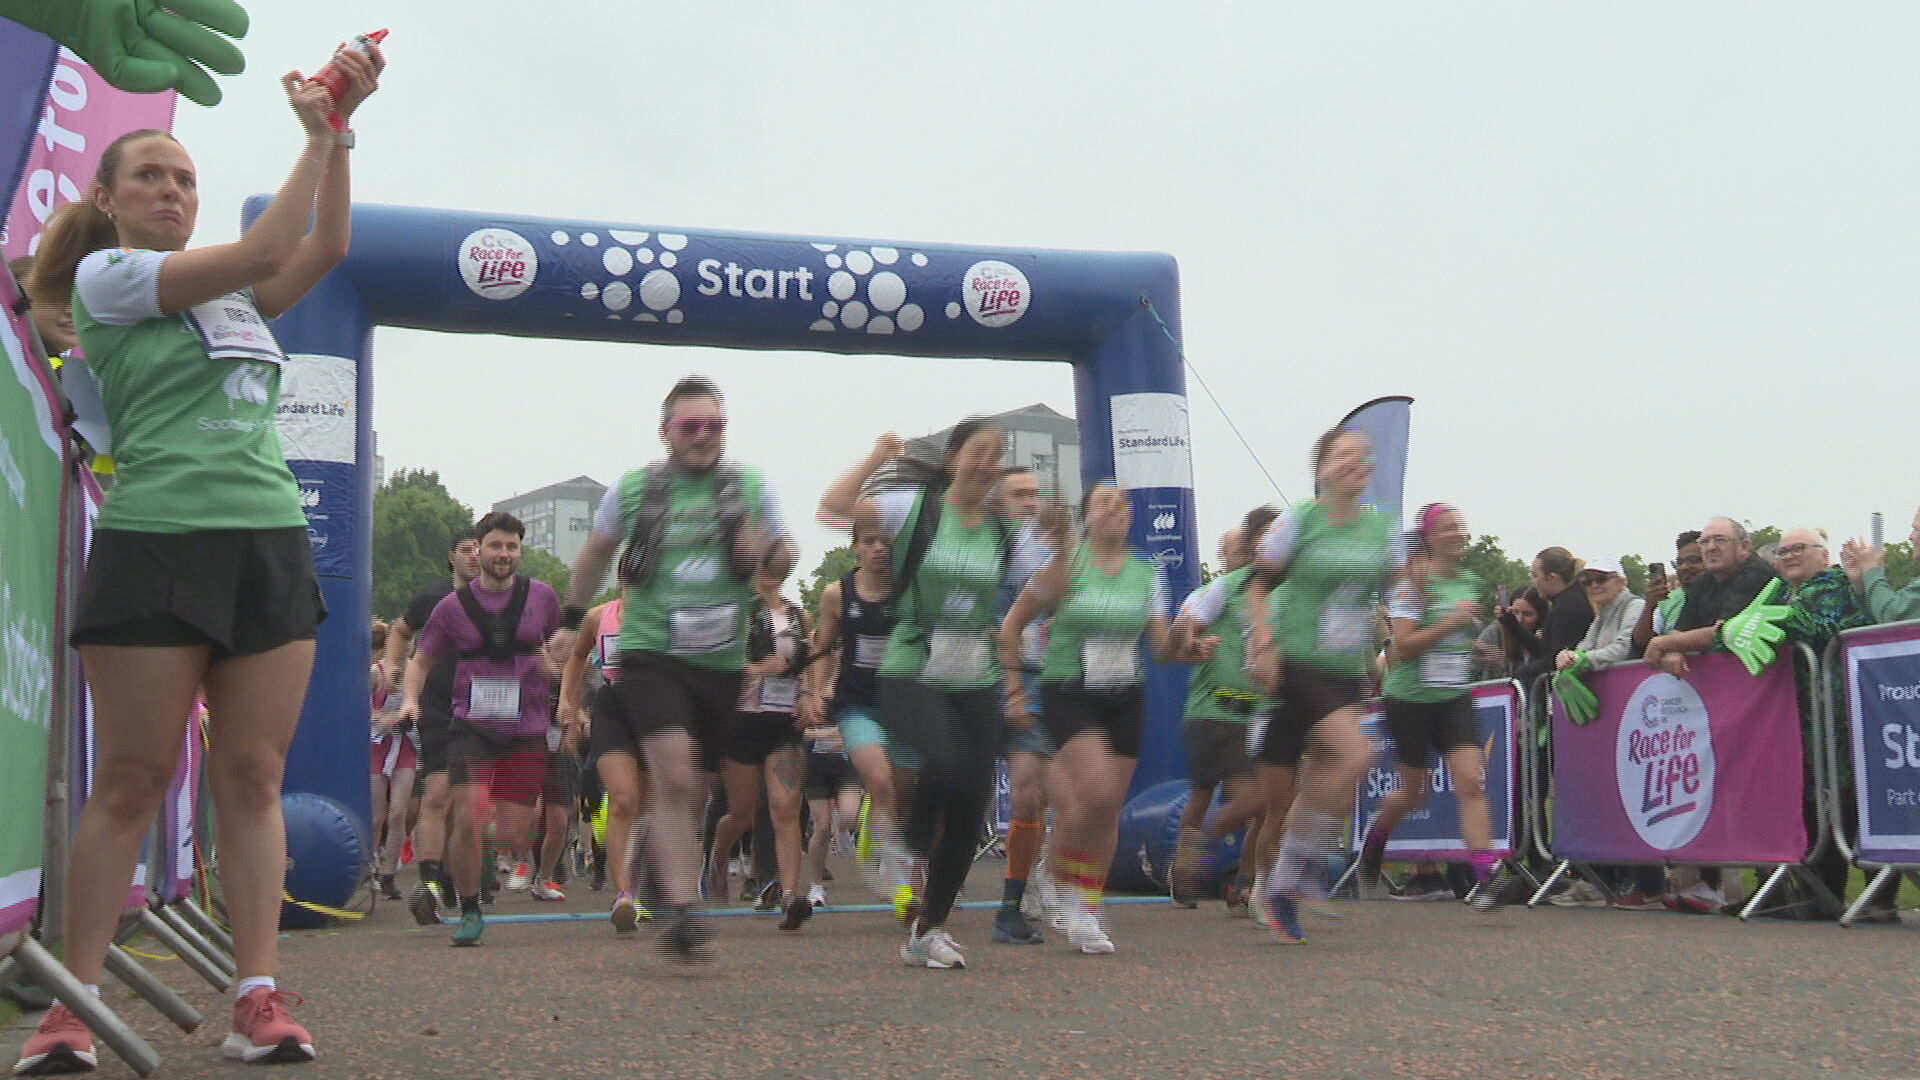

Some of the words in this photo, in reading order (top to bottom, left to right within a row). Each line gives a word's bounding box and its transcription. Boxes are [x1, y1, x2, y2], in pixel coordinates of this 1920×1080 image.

[469, 246, 503, 261] Race
[505, 248, 524, 260] for
[478, 260, 526, 283] Life
[696, 257, 814, 302] Start
[971, 277, 1001, 292] Race
[979, 289, 1021, 312] Life
[321, 404, 346, 418] Life
[1118, 434, 1168, 449] Standard
[1168, 435, 1185, 447] Life
[1628, 726, 1671, 764] Race
[1672, 723, 1697, 751] for
[1641, 752, 1702, 812] Life
[1886, 788, 1917, 808] Part
